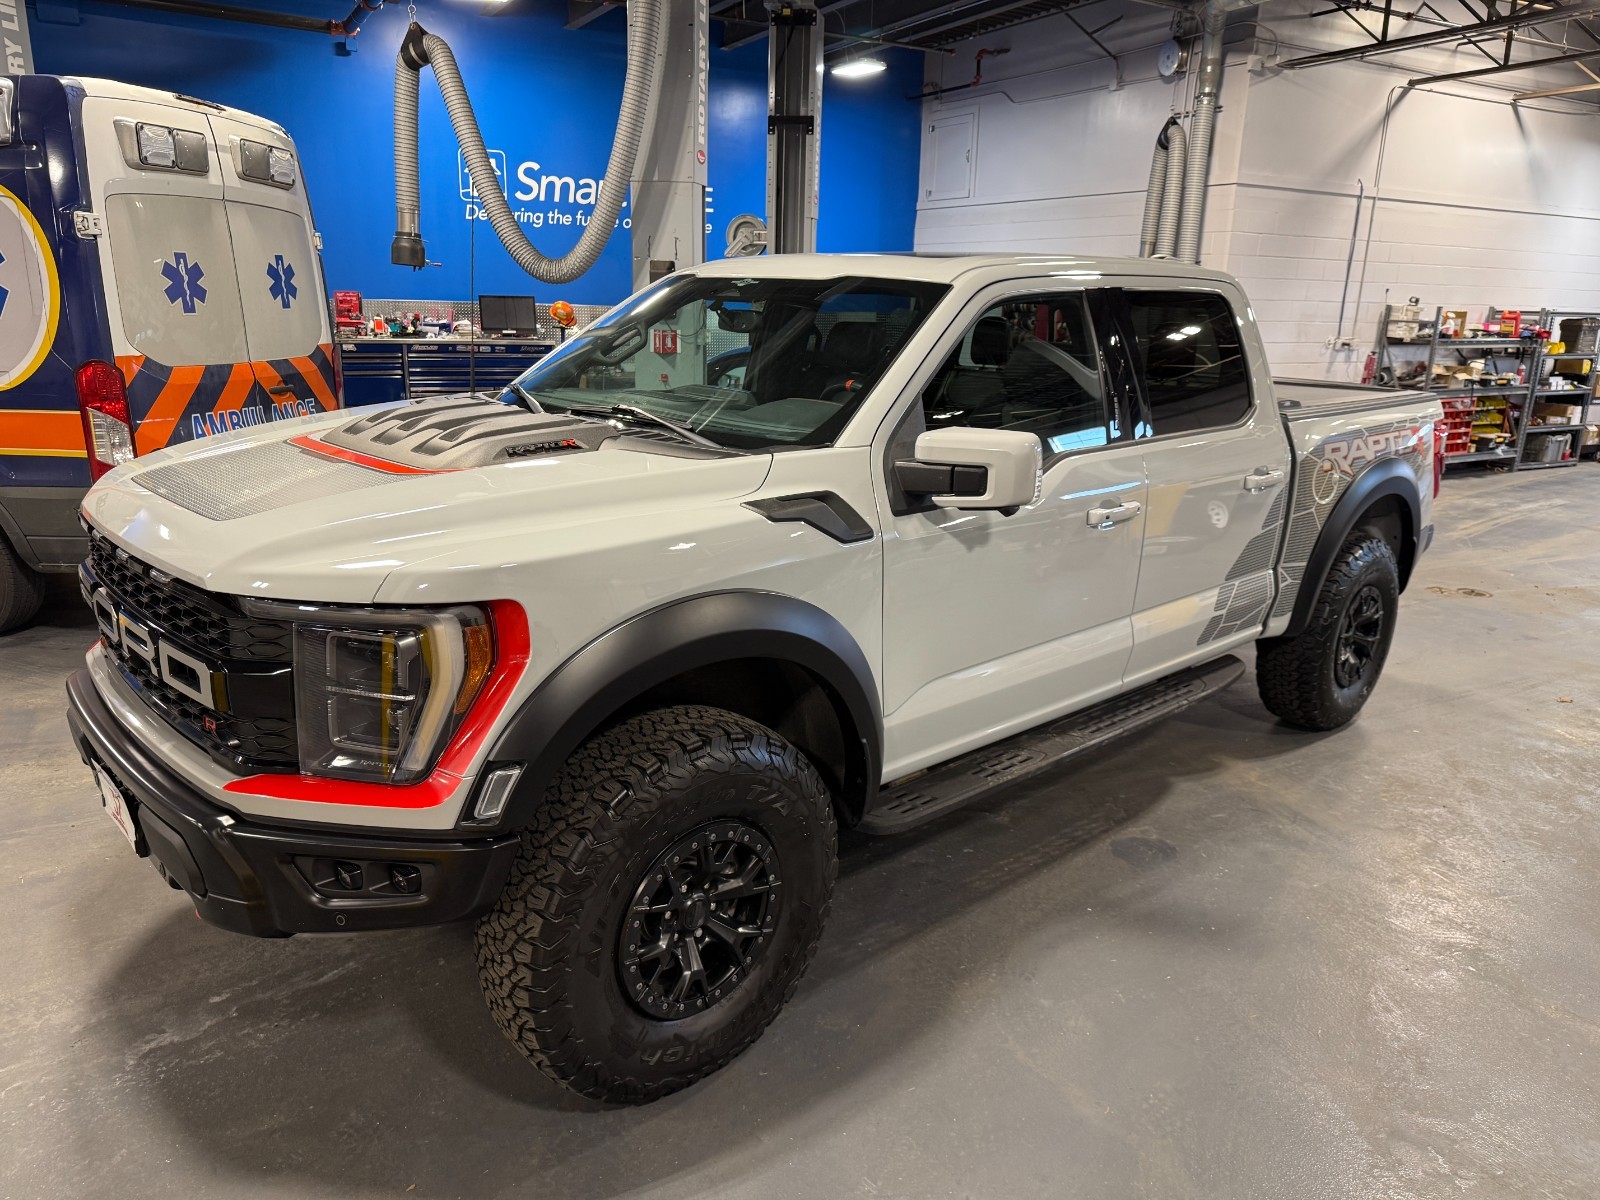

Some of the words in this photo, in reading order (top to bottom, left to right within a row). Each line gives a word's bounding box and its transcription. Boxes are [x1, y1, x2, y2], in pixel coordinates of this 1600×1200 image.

[698, 29, 706, 145] ROTARY
[465, 204, 544, 228] Dering
[547, 208, 573, 225] the
